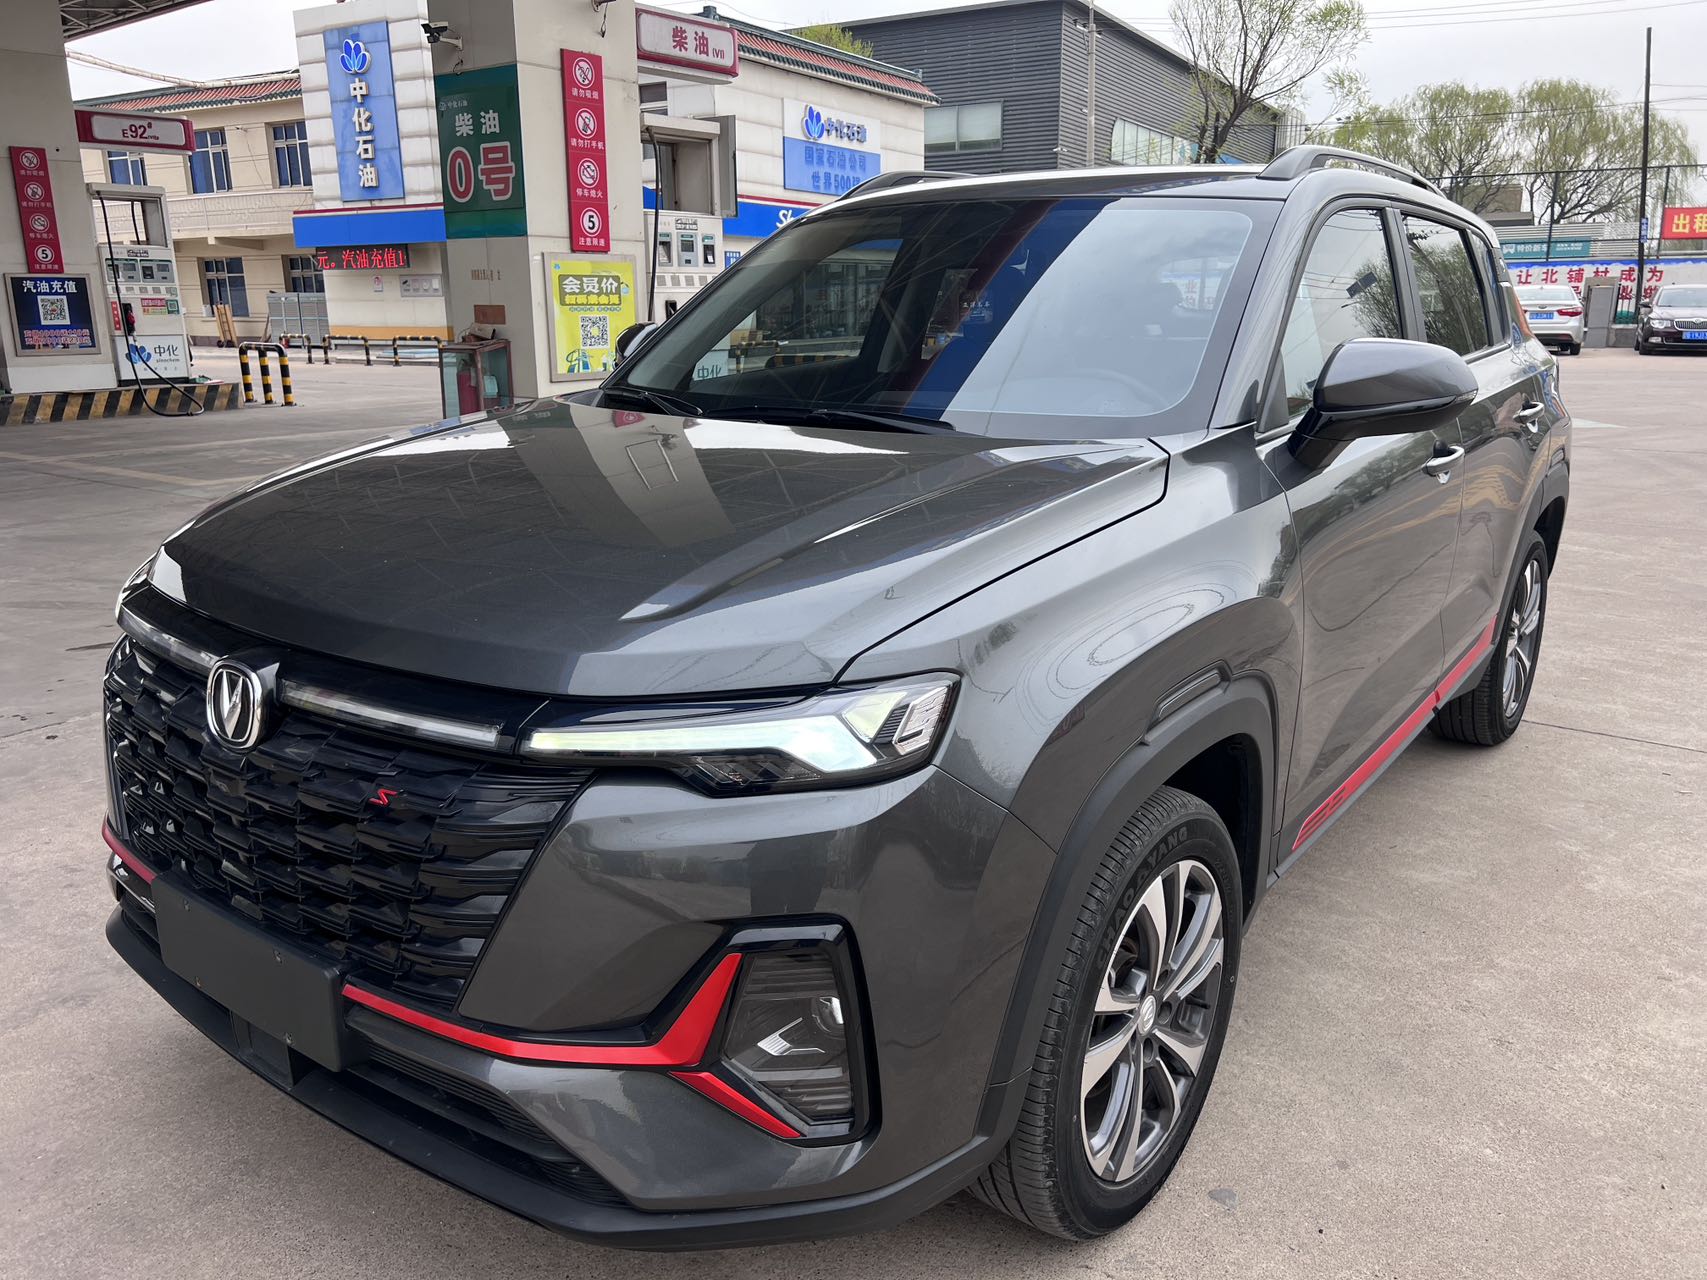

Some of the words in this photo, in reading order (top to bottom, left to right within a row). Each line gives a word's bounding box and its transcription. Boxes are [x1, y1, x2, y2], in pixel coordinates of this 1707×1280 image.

[672, 26, 709, 56] 柴油
[350, 78, 379, 187] 中化石油
[455, 109, 500, 137] 柴油
[825, 117, 867, 143] 中化石油
[804, 145, 867, 172] 国家石油公司
[447, 141, 516, 203] 0号
[587, 214, 596, 231] 5
[1671, 213, 1707, 234] 出租
[41, 249, 49, 260] 5
[317, 247, 407, 270] 元。汽油充值1
[22, 280, 78, 293] 汽油充值
[562, 276, 619, 294] 会员价
[153, 344, 179, 357] 中化
